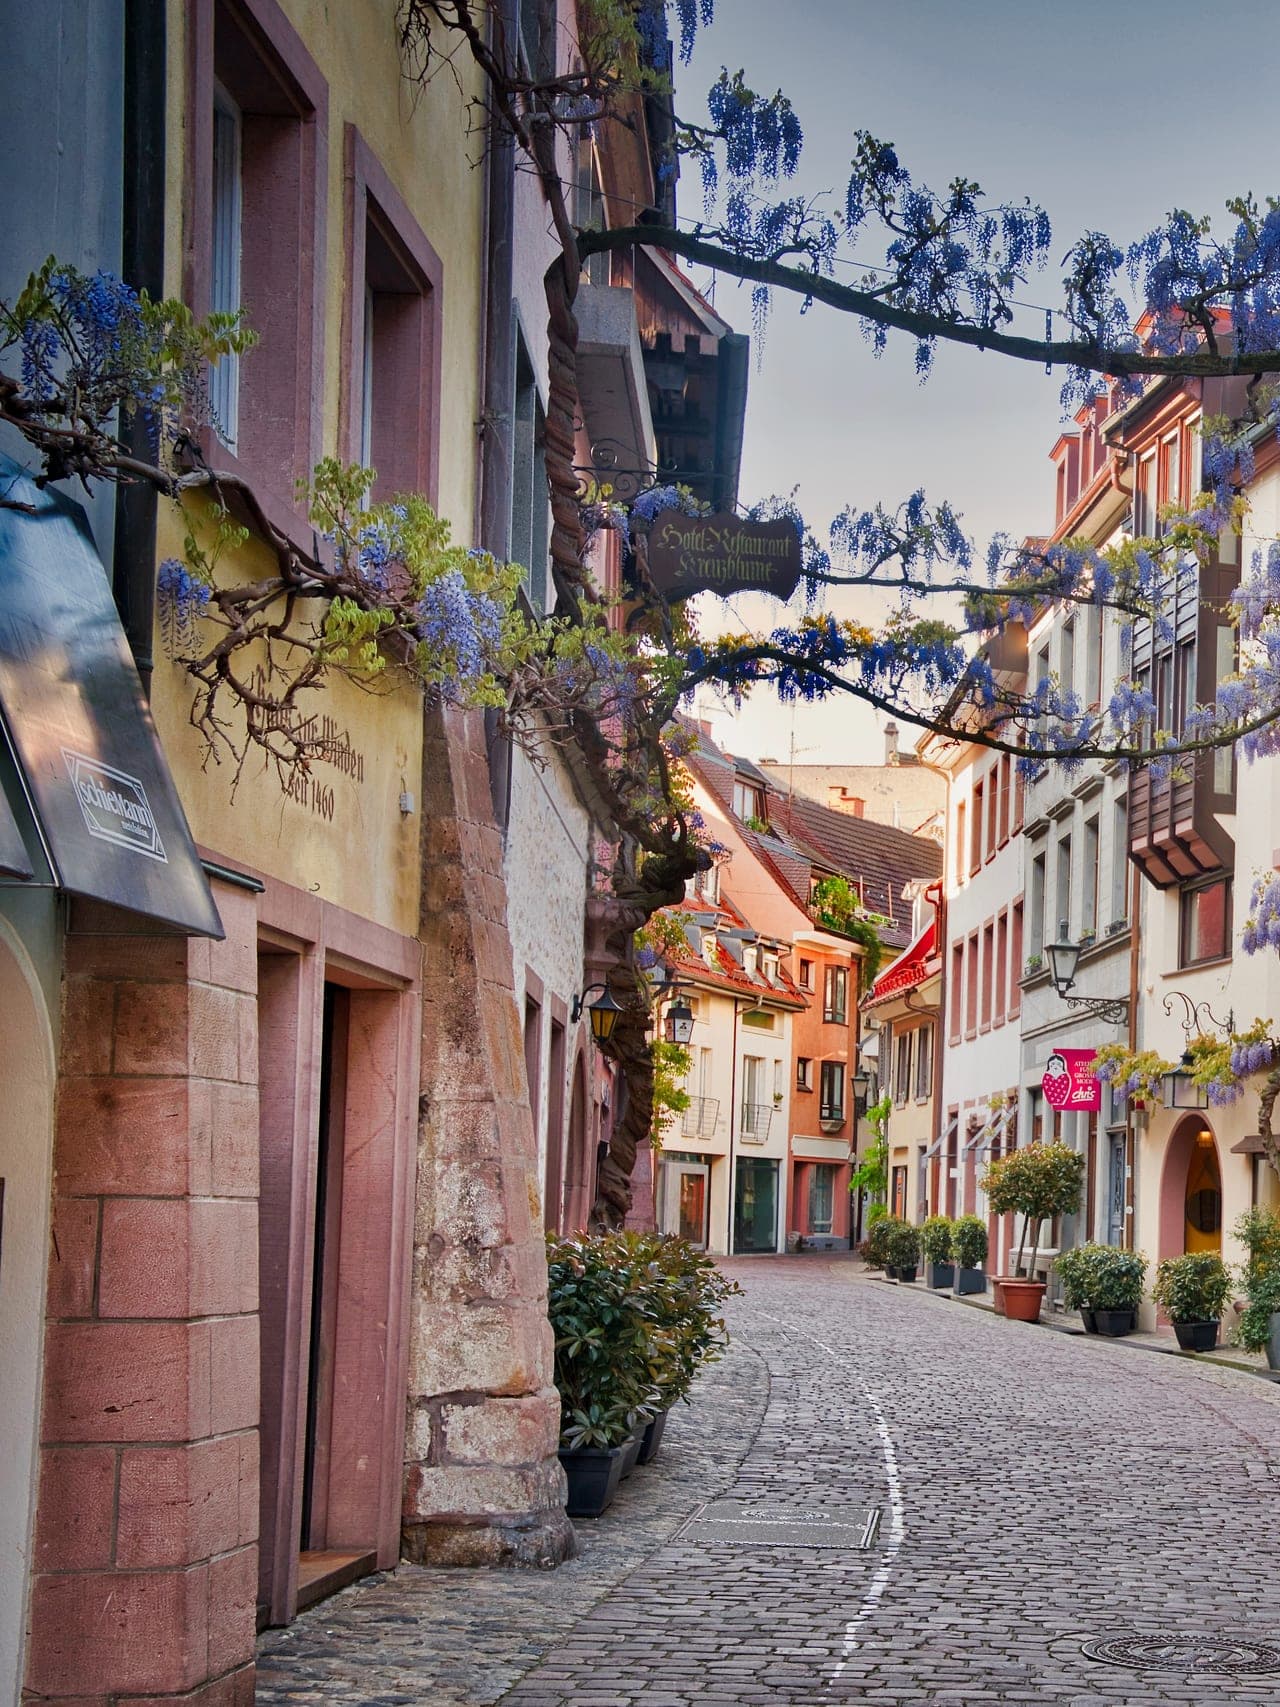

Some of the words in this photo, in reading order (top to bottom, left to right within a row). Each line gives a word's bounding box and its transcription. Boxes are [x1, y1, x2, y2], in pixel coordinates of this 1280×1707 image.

[656, 524, 792, 558] Hotel-Restaurant
[674, 553, 778, 585] Kreuzblume
[311, 779, 335, 822] 1460
